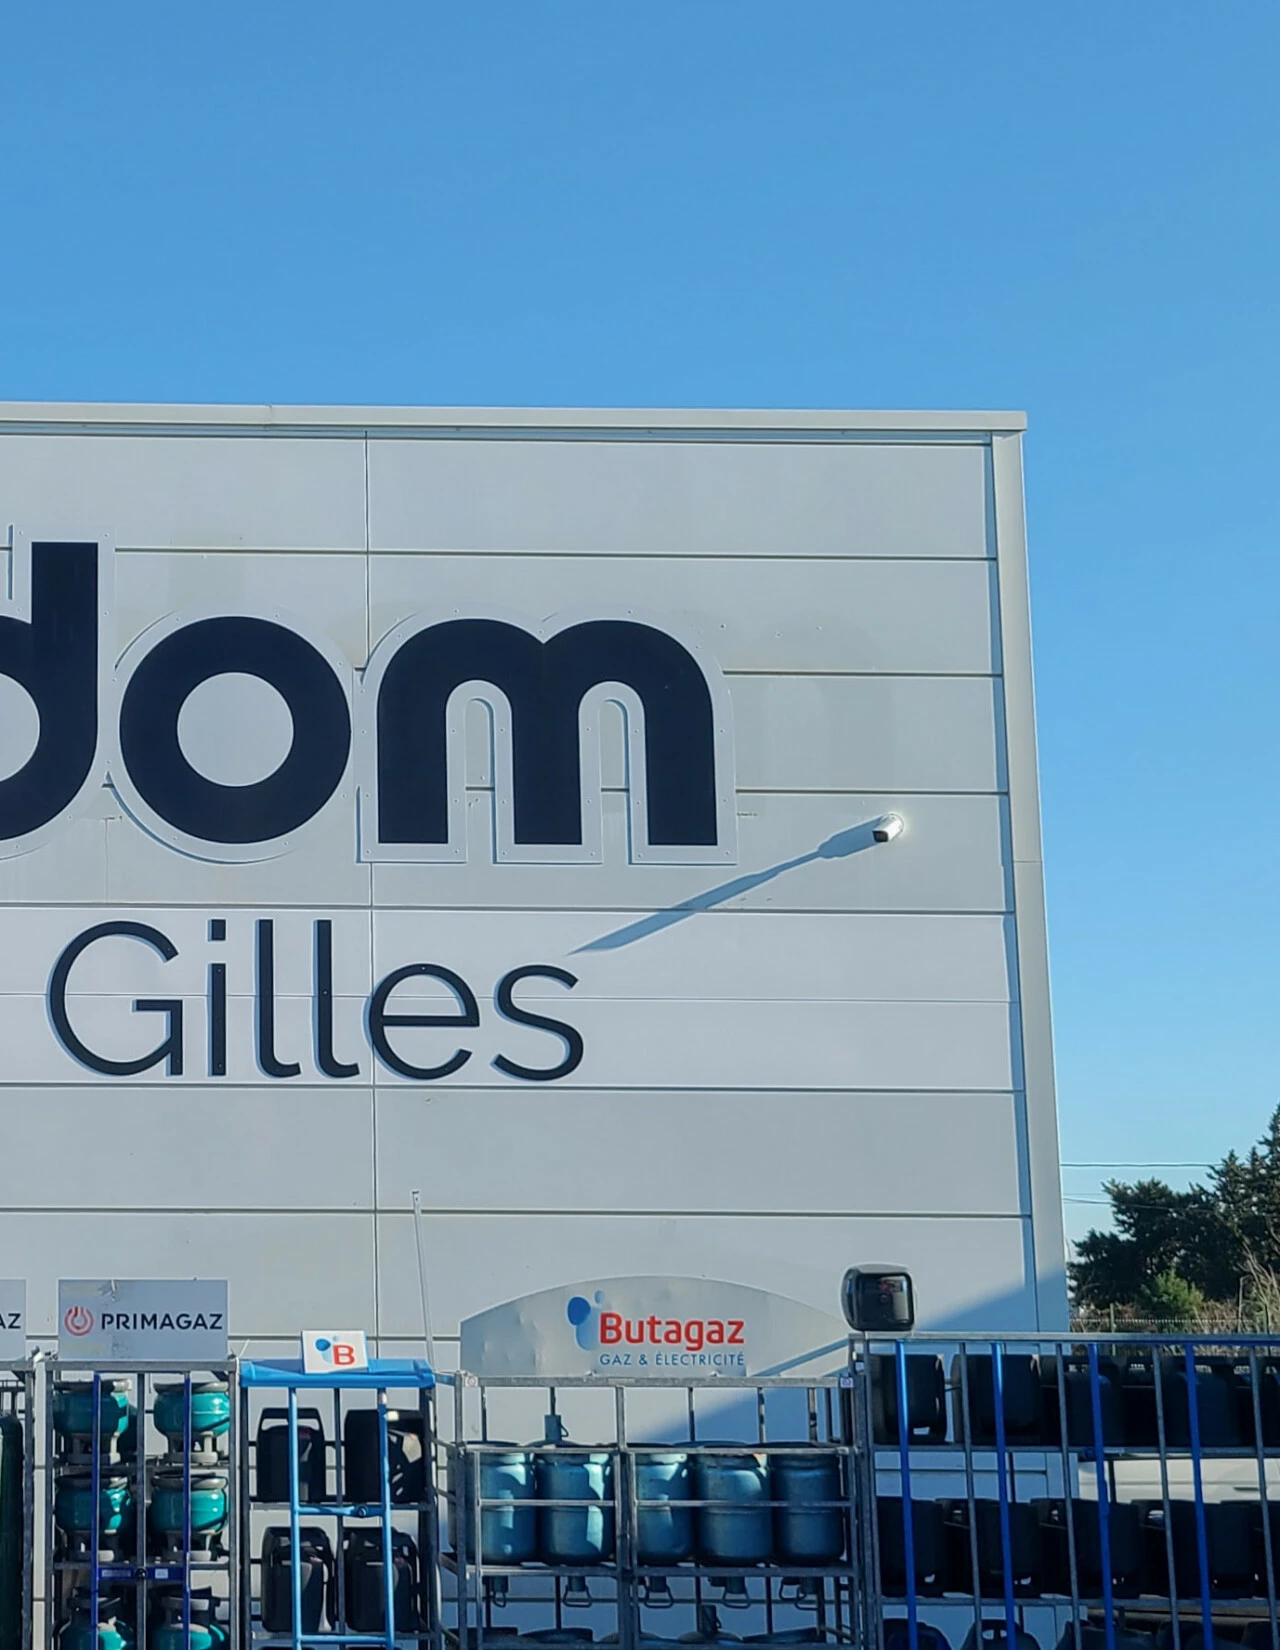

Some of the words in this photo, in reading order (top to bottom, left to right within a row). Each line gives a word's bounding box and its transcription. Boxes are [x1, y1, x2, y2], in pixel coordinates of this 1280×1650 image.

[48, 918, 585, 1080] Gilles
[101, 1312, 224, 1331] PRIMAGAZ
[599, 1312, 746, 1352] Butagaz
[332, 1344, 356, 1366] B
[599, 1353, 632, 1366] GAZ
[638, 1353, 649, 1366] &
[655, 1351, 746, 1367] ÉLECTRICITÉ
